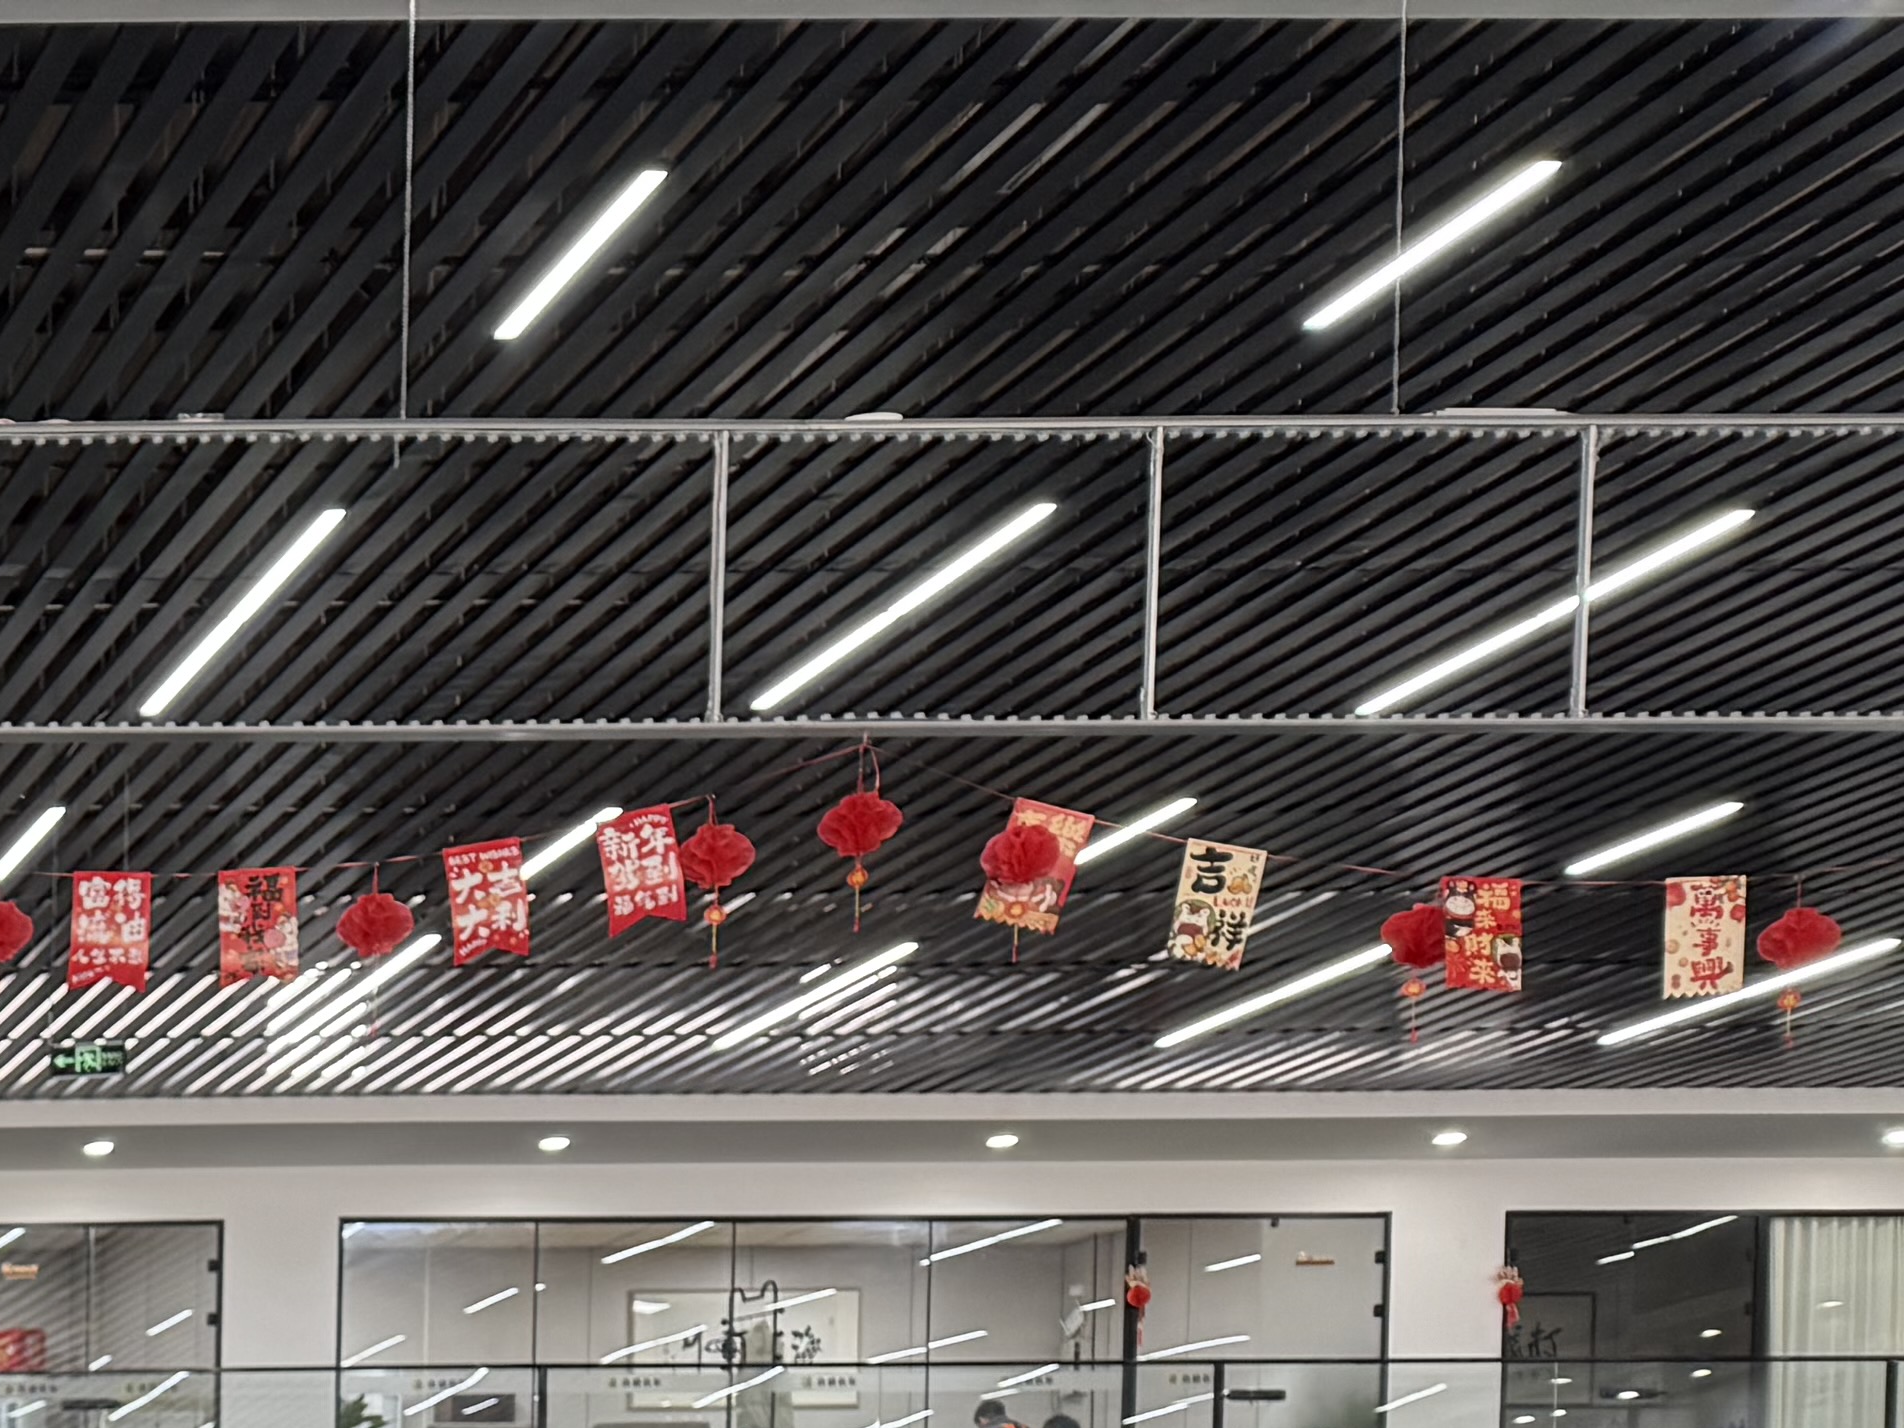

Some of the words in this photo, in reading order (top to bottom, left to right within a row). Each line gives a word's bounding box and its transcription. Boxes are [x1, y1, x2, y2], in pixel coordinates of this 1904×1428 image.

[448, 852, 477, 866] BEST
[597, 822, 676, 860] 新年
[451, 861, 522, 905] 大吉
[457, 898, 528, 941] 大利
